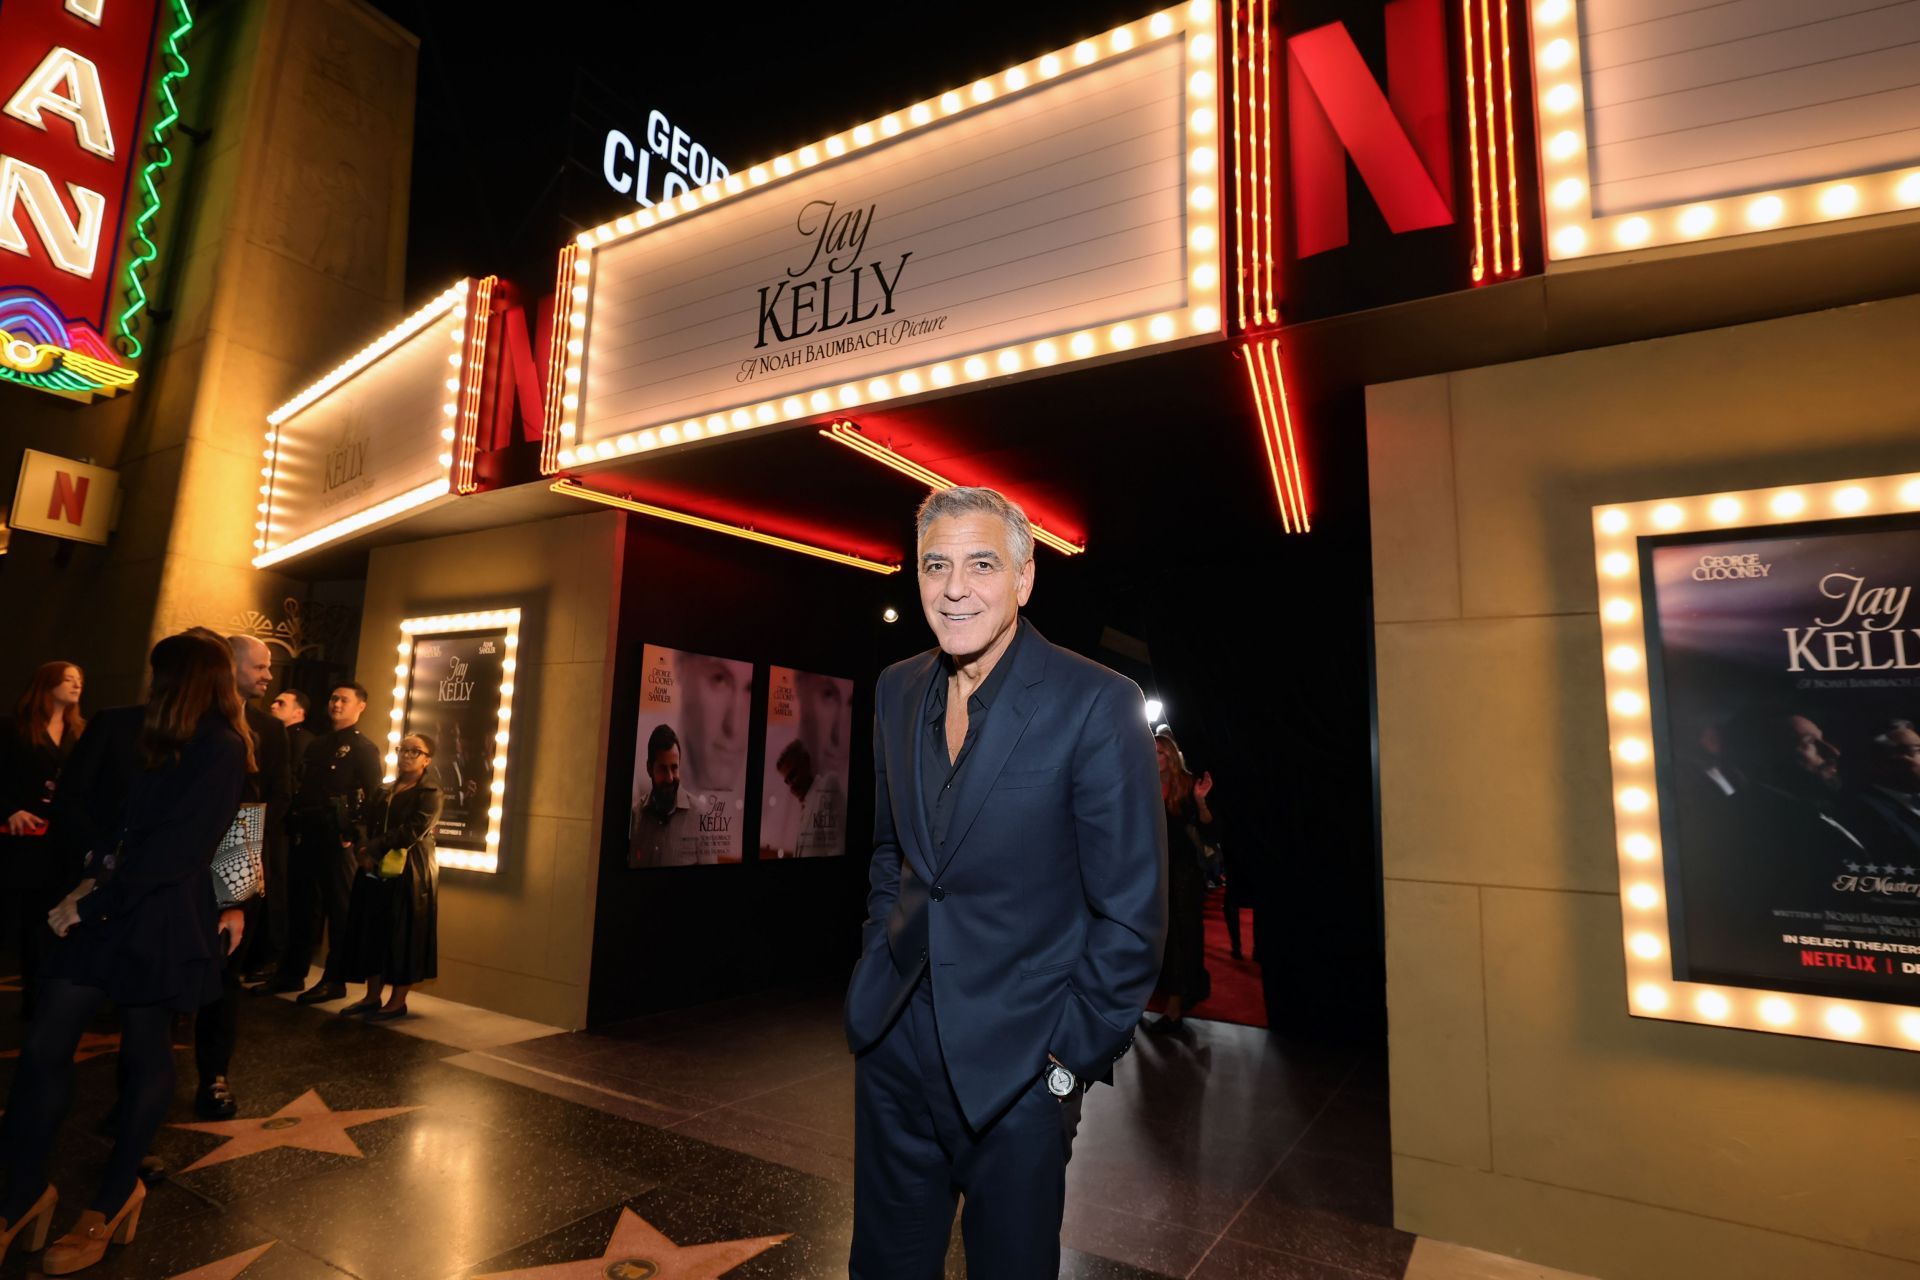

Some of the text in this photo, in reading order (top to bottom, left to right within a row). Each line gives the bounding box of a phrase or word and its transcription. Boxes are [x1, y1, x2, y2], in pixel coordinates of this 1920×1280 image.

[786, 200, 877, 278] Jay
[753, 251, 914, 349] KELLY
[736, 315, 949, 383] A NOAH BAUMBACH Picture
[321, 437, 371, 494] KELLY
[47, 470, 91, 527] N
[1692, 563, 1772, 581] CLOONEY
[1700, 553, 1760, 569] GEORGE
[1814, 572, 1912, 632] Jay
[1782, 626, 1920, 673] KELL
[446, 655, 469, 684] Jay
[438, 680, 475, 702] KELLY
[706, 794, 726, 818] Jay
[699, 814, 733, 832] KELLY
[1782, 934, 1798, 945] IN
[1799, 935, 1850, 949] SELECT
[1801, 950, 1877, 974] NETFLIX
